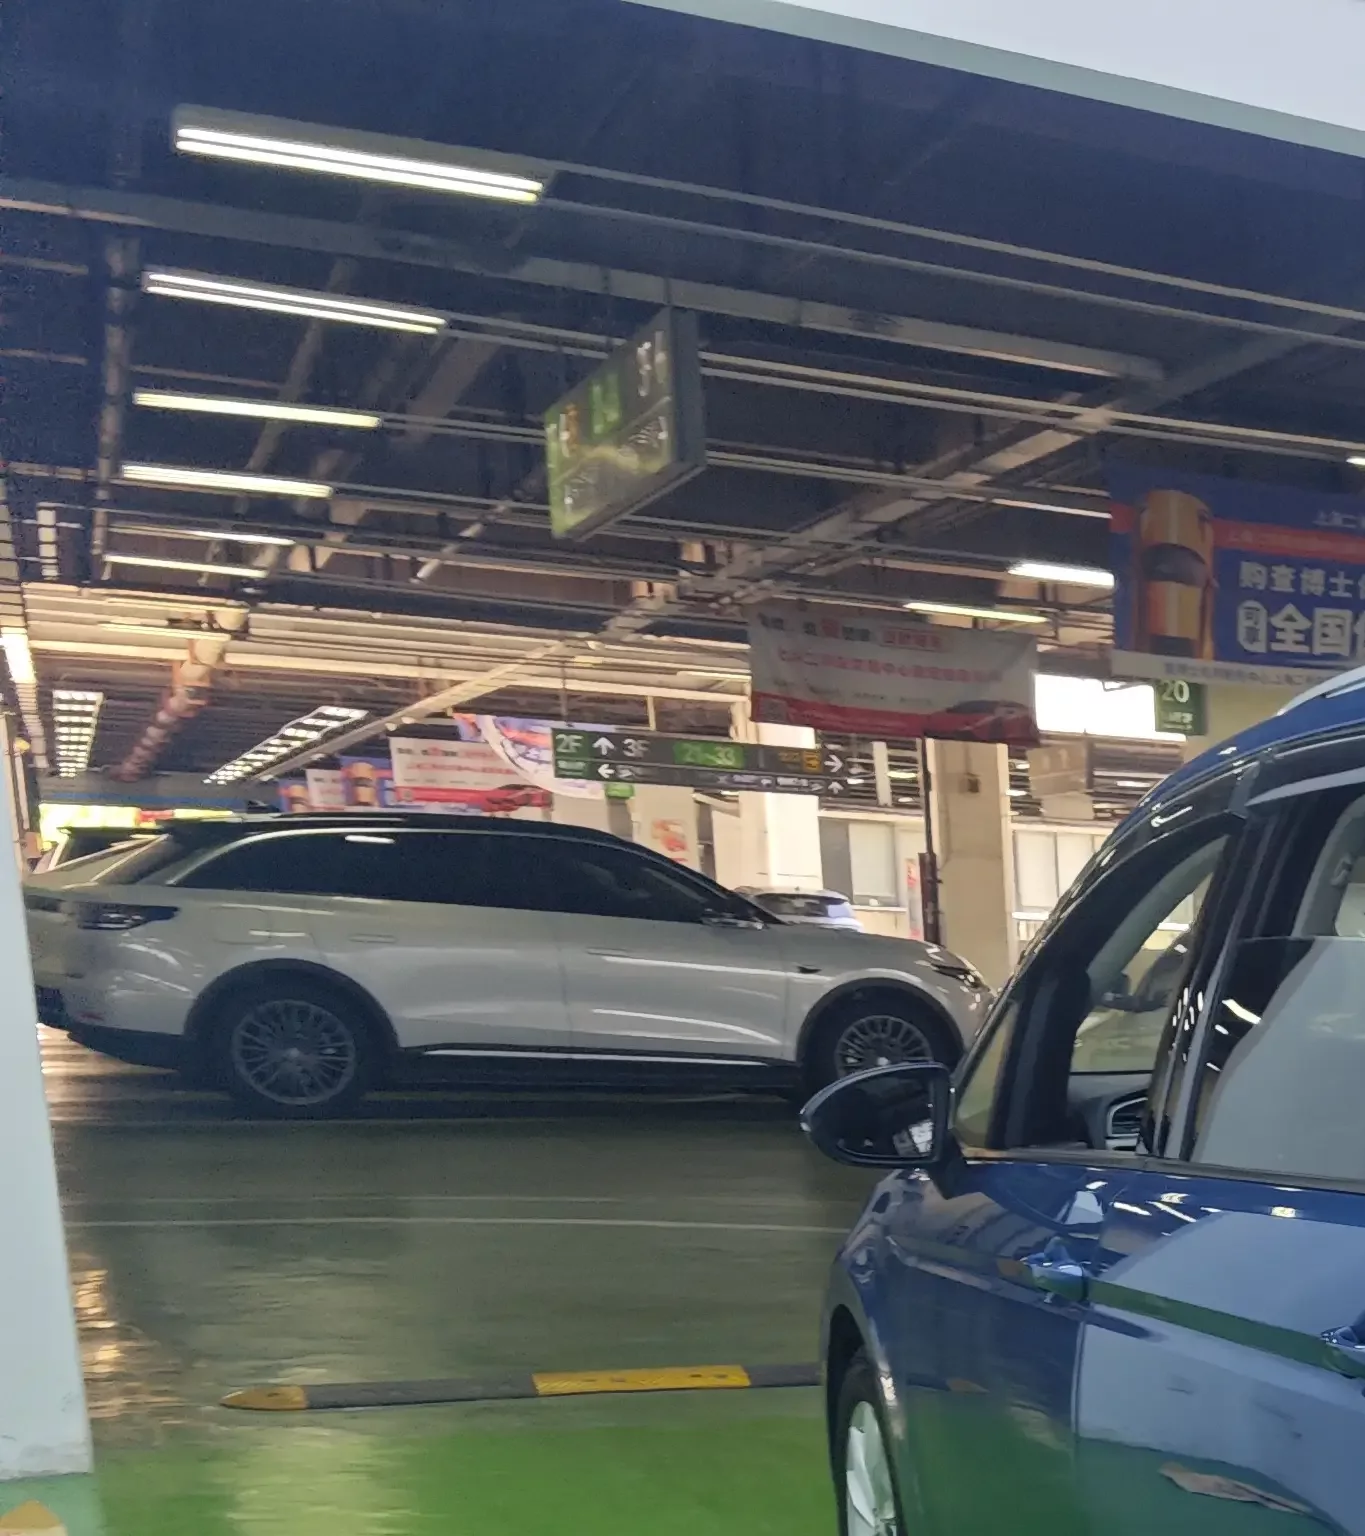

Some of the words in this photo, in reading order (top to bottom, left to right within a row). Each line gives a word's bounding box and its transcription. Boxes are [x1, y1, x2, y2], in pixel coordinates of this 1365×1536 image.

[1161, 680, 1190, 703] 20
[555, 733, 584, 753] 2F
[622, 738, 651, 758] 3F
